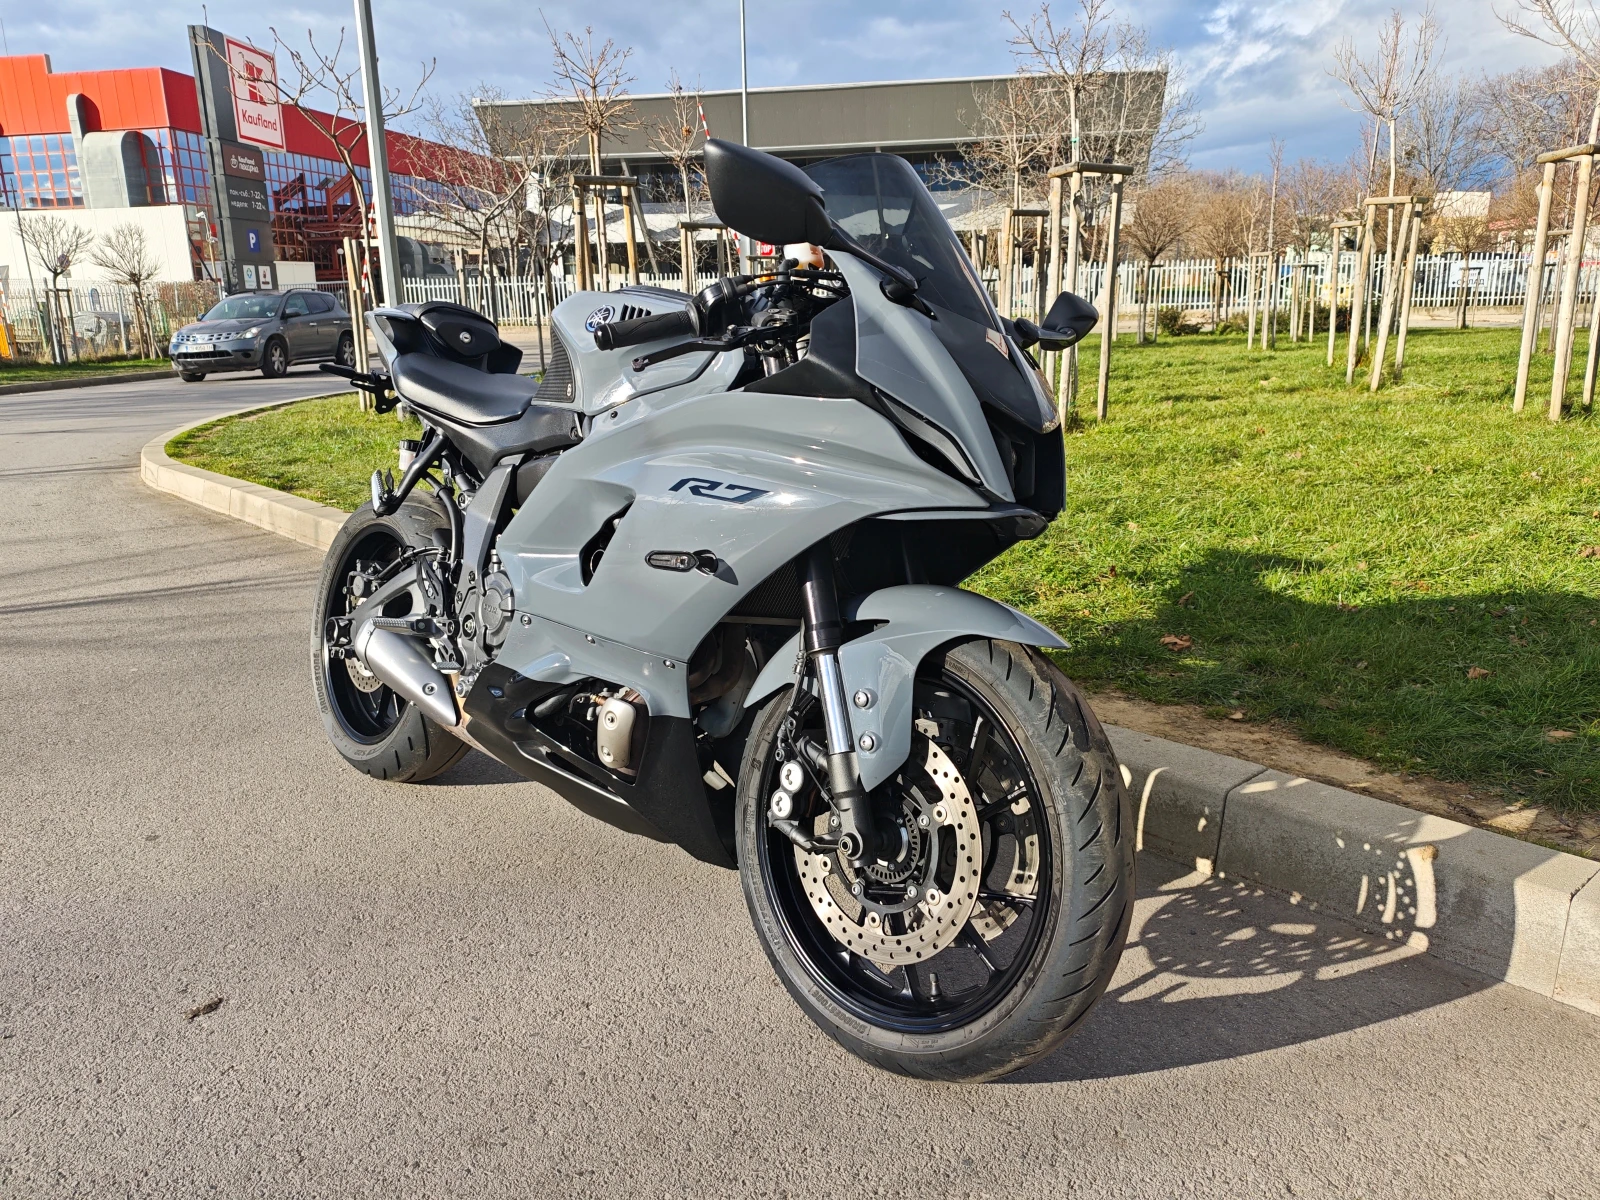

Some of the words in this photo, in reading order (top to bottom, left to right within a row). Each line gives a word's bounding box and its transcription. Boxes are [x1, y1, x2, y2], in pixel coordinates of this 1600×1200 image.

[241, 108, 278, 131] Kaufland
[238, 155, 255, 166] Kaufland
[239, 163, 259, 173] пекарна
[249, 232, 257, 249] P
[667, 477, 772, 505] R7
[811, 989, 868, 1035] BRIDGESTONE
